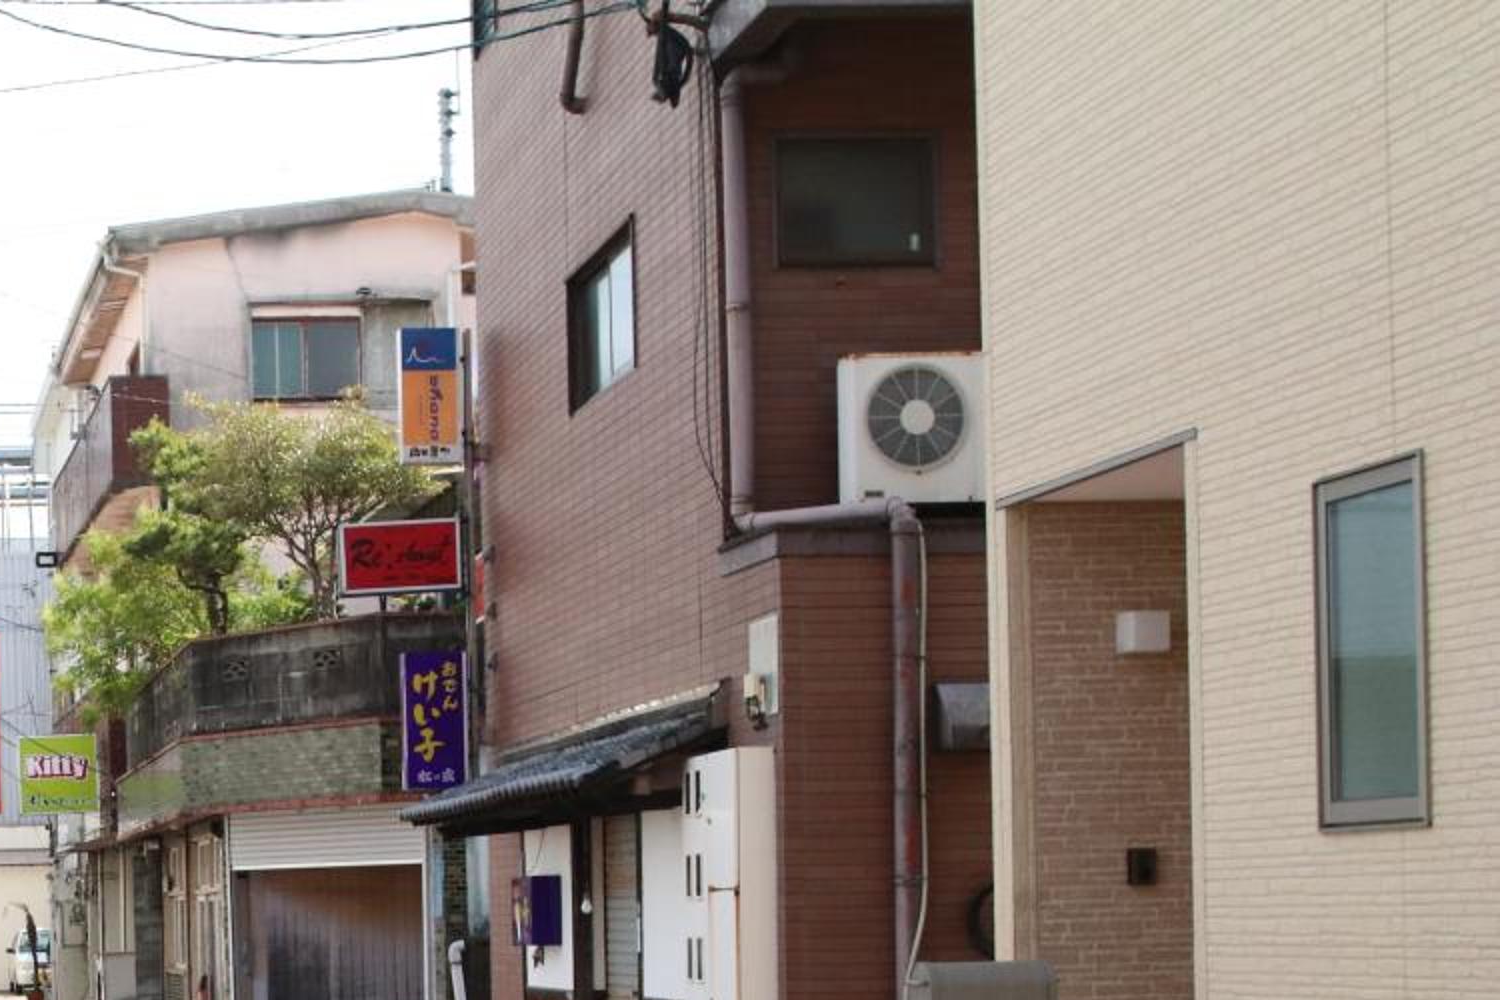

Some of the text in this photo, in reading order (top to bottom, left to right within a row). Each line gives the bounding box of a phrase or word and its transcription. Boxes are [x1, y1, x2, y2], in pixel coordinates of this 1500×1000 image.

[413, 671, 445, 762] けい子
[443, 662, 457, 710] おでん
